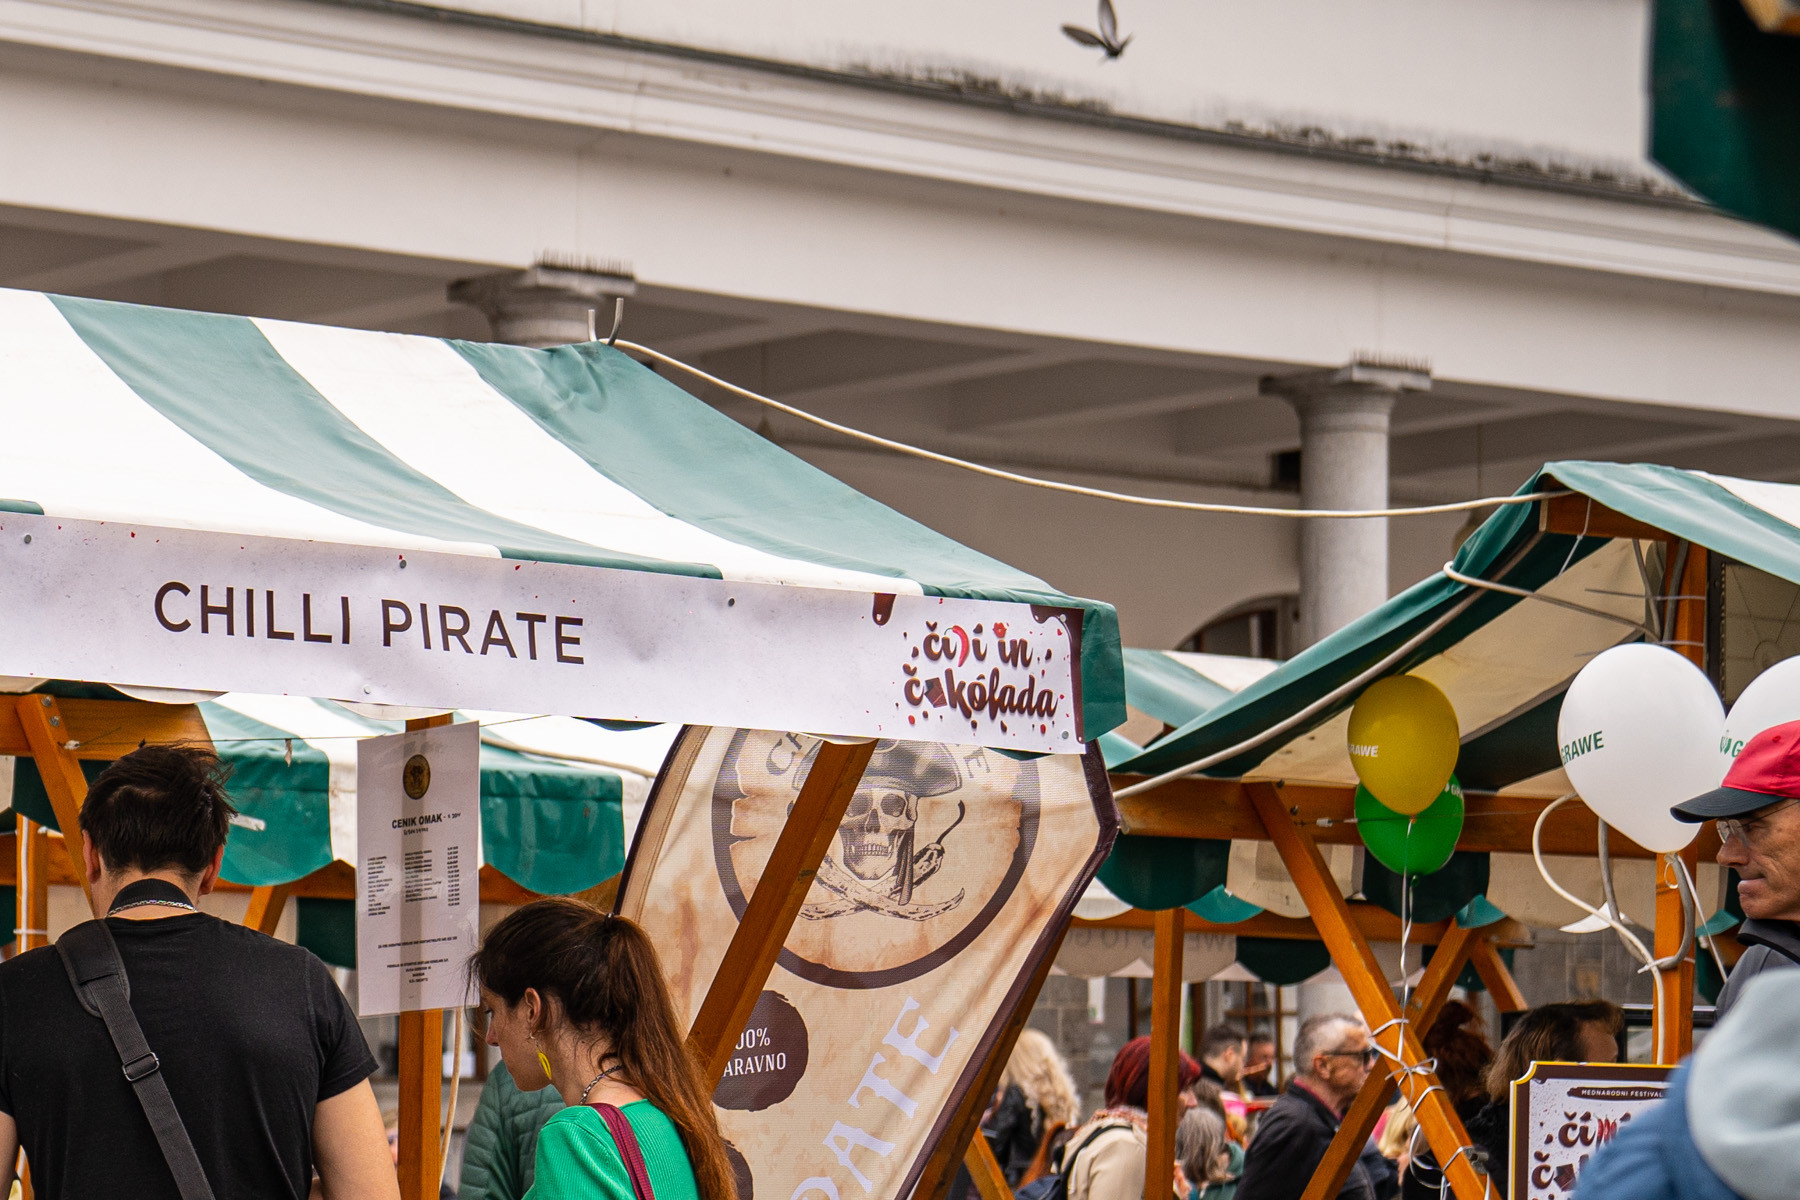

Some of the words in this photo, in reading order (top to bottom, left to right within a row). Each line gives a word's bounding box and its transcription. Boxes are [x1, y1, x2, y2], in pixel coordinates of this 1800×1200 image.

[154, 581, 350, 645] CHILLI
[381, 598, 585, 665] PIRATE
[1349, 744, 1378, 757] RAWE
[391, 816, 417, 829] CENIK
[418, 813, 443, 825] OMAK
[735, 1027, 771, 1050] 00%
[723, 1052, 786, 1077] ARAVNO
[1581, 1088, 1629, 1097] MEDNARODNI
[1630, 1090, 1664, 1098] FESTIVAL
